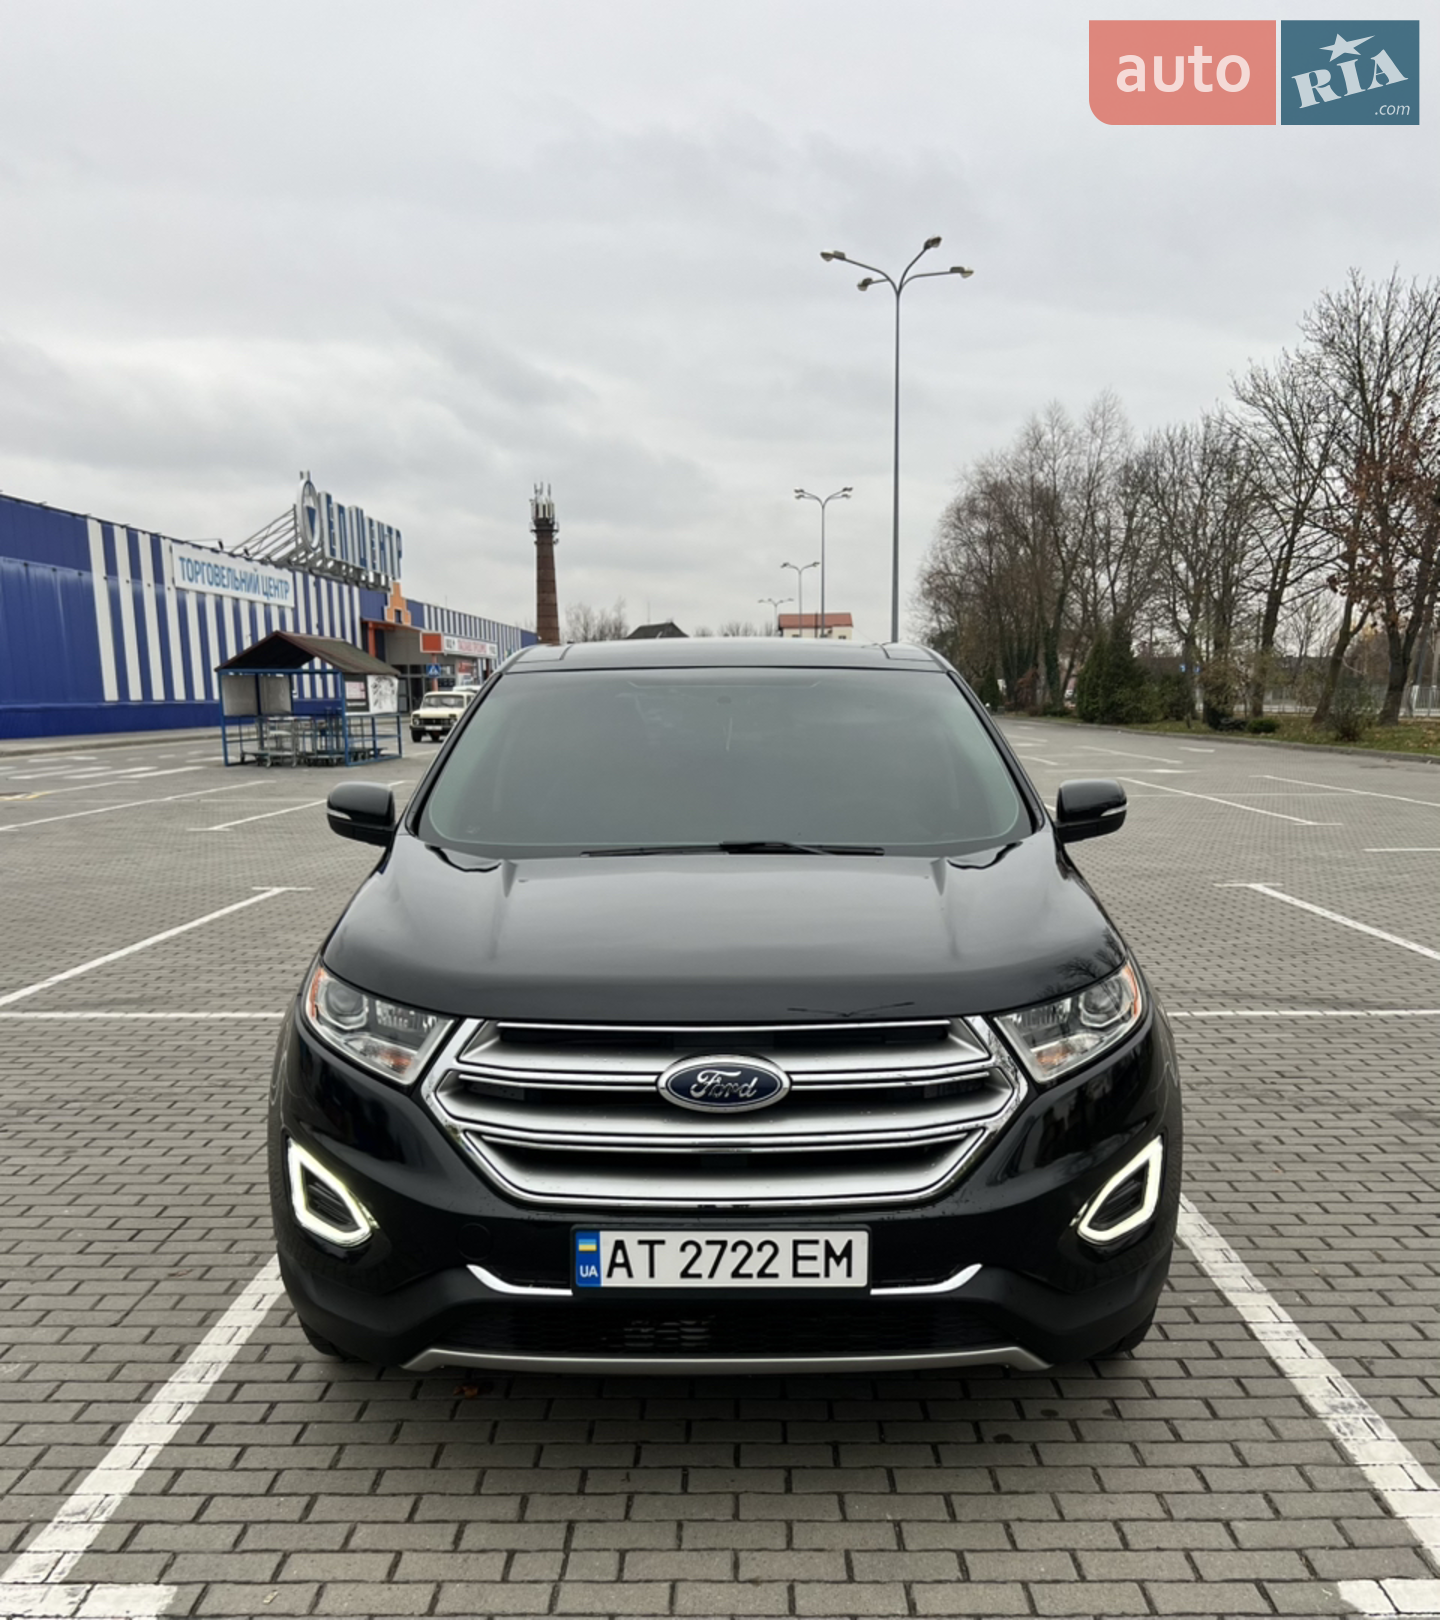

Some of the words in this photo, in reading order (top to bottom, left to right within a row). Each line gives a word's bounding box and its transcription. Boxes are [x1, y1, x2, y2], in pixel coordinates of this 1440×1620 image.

[178, 555, 260, 595] ТОРГОВЕЛЬНИЙ
[261, 575, 291, 601] ЦЕНТР
[690, 1069, 759, 1098] Ford
[579, 1265, 599, 1278] UA
[606, 1239, 666, 1279] AT
[679, 1239, 780, 1279] 2722
[791, 1239, 853, 1279] EM
